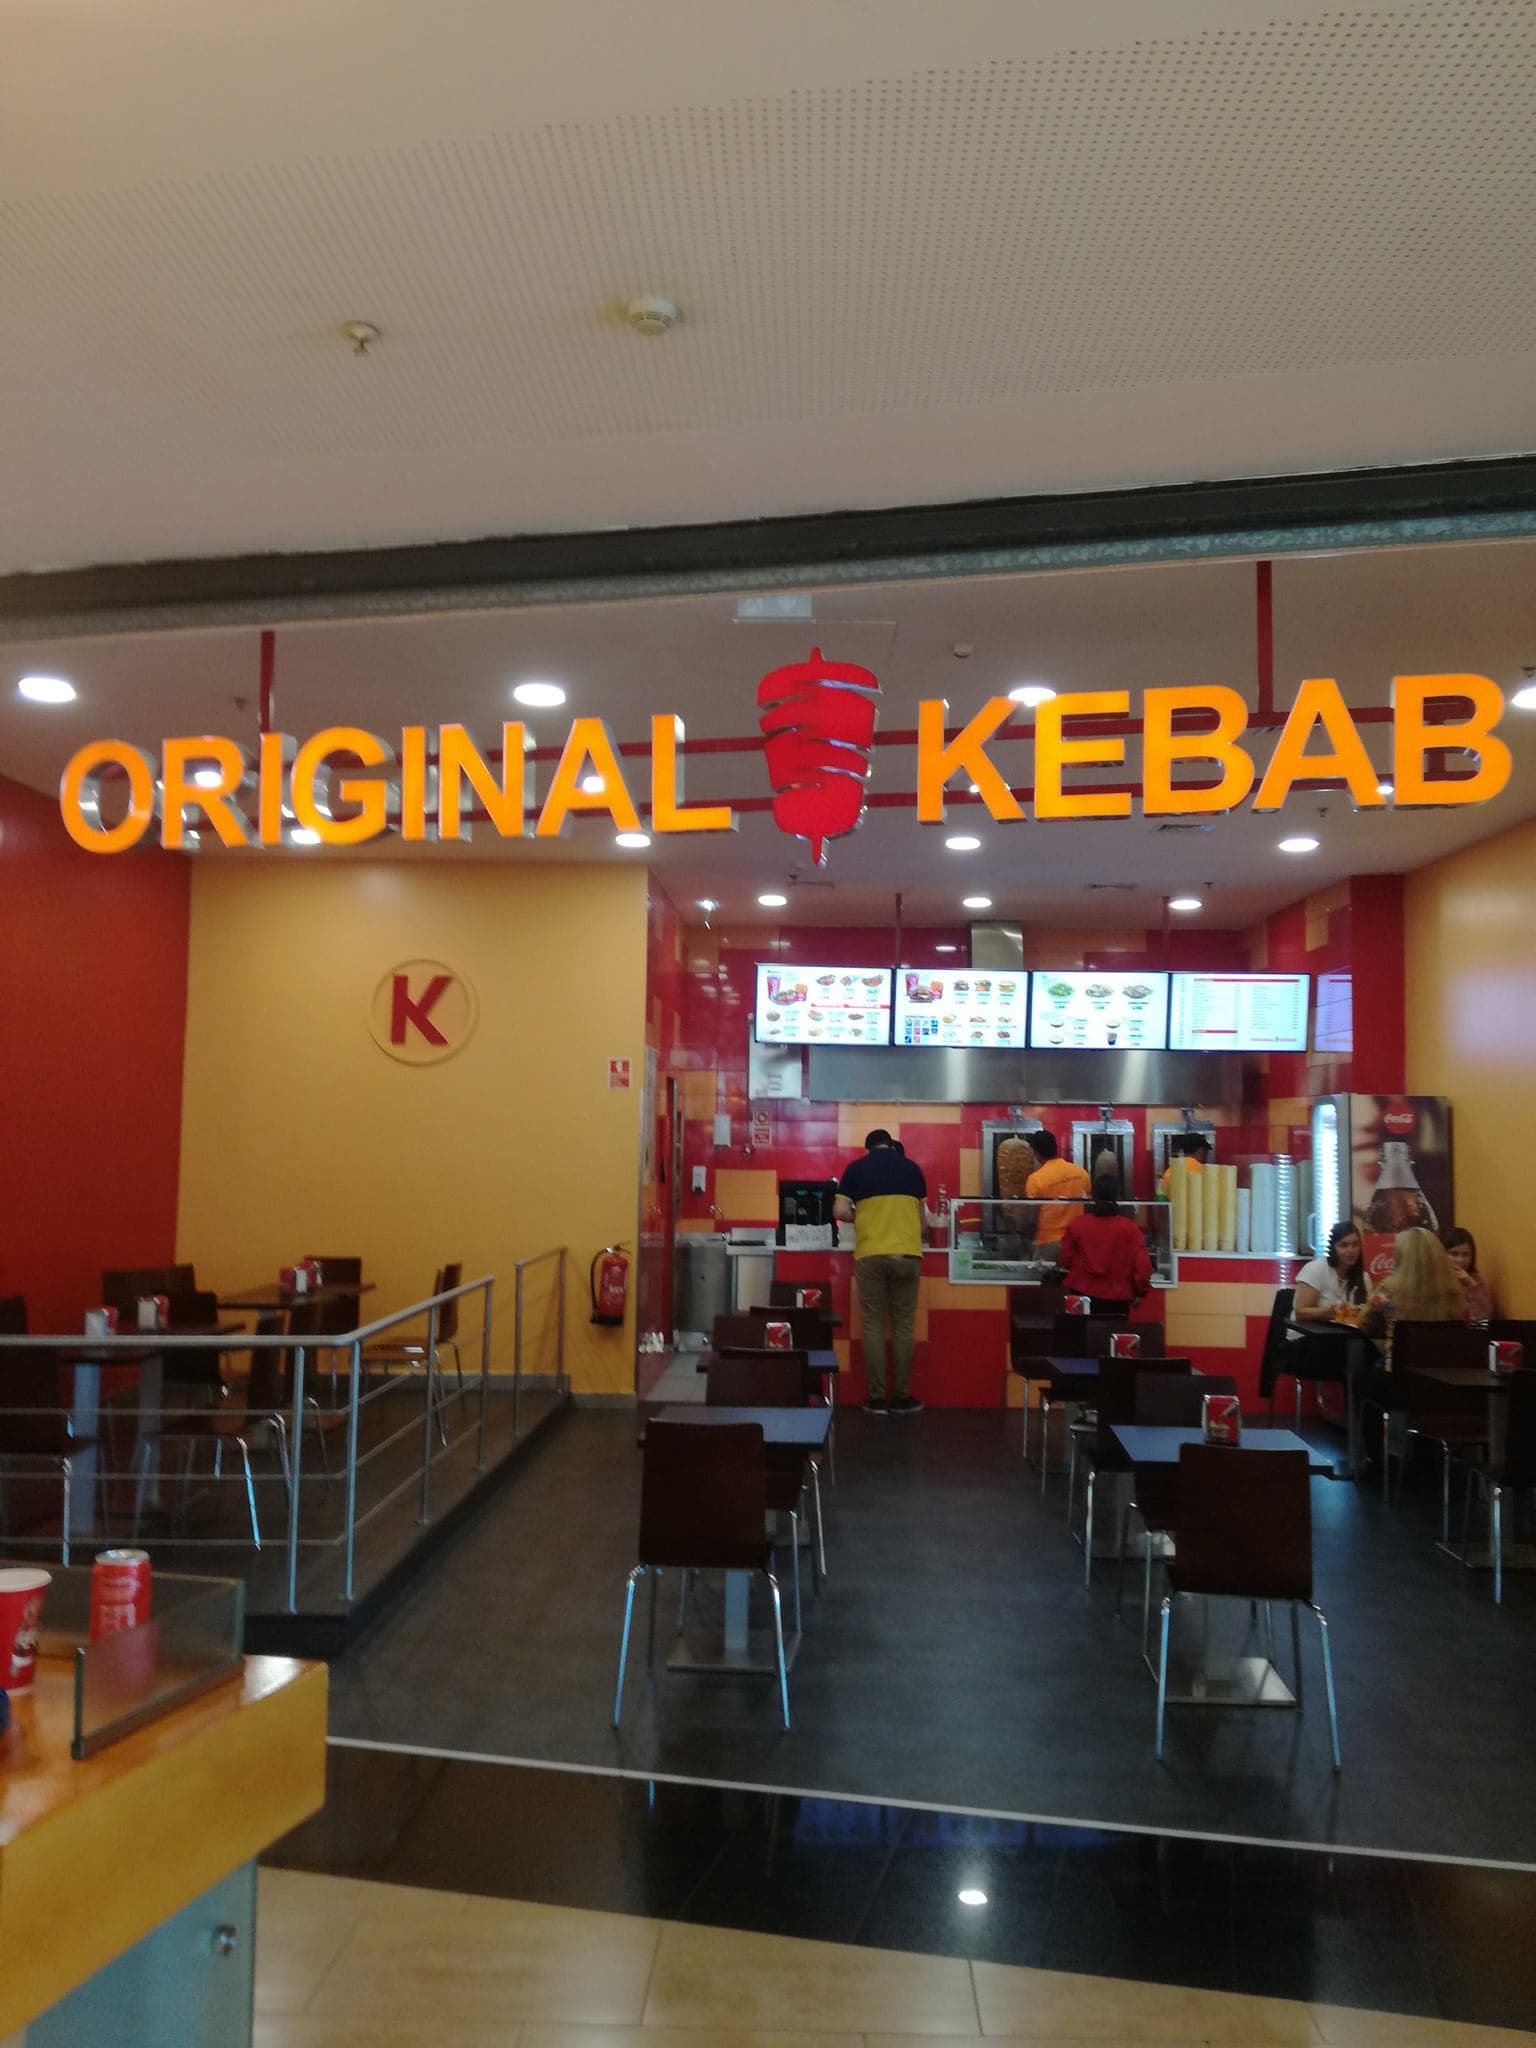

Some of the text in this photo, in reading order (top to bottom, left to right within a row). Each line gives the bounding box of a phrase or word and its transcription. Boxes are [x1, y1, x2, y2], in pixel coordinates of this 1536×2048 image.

[60, 674, 1513, 855] ORIGINAL KEBAB
[391, 973, 452, 1046] K
